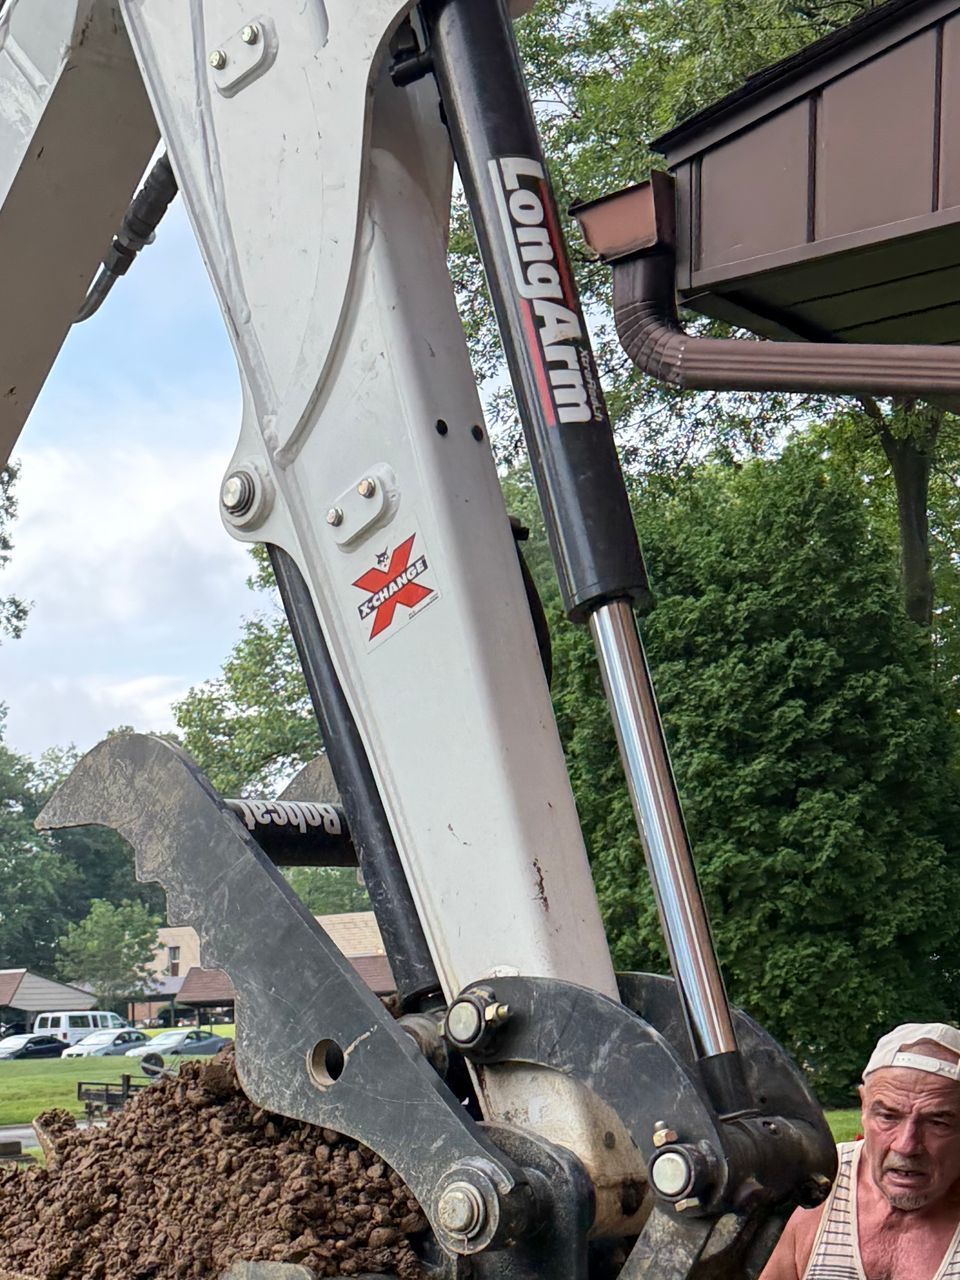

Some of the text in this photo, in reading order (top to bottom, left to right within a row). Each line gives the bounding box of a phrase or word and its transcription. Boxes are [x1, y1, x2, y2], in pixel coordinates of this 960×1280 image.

[490, 156, 593, 424] LongArm
[359, 558, 426, 617] X-CHANGE
[241, 801, 342, 835] Bobcat
